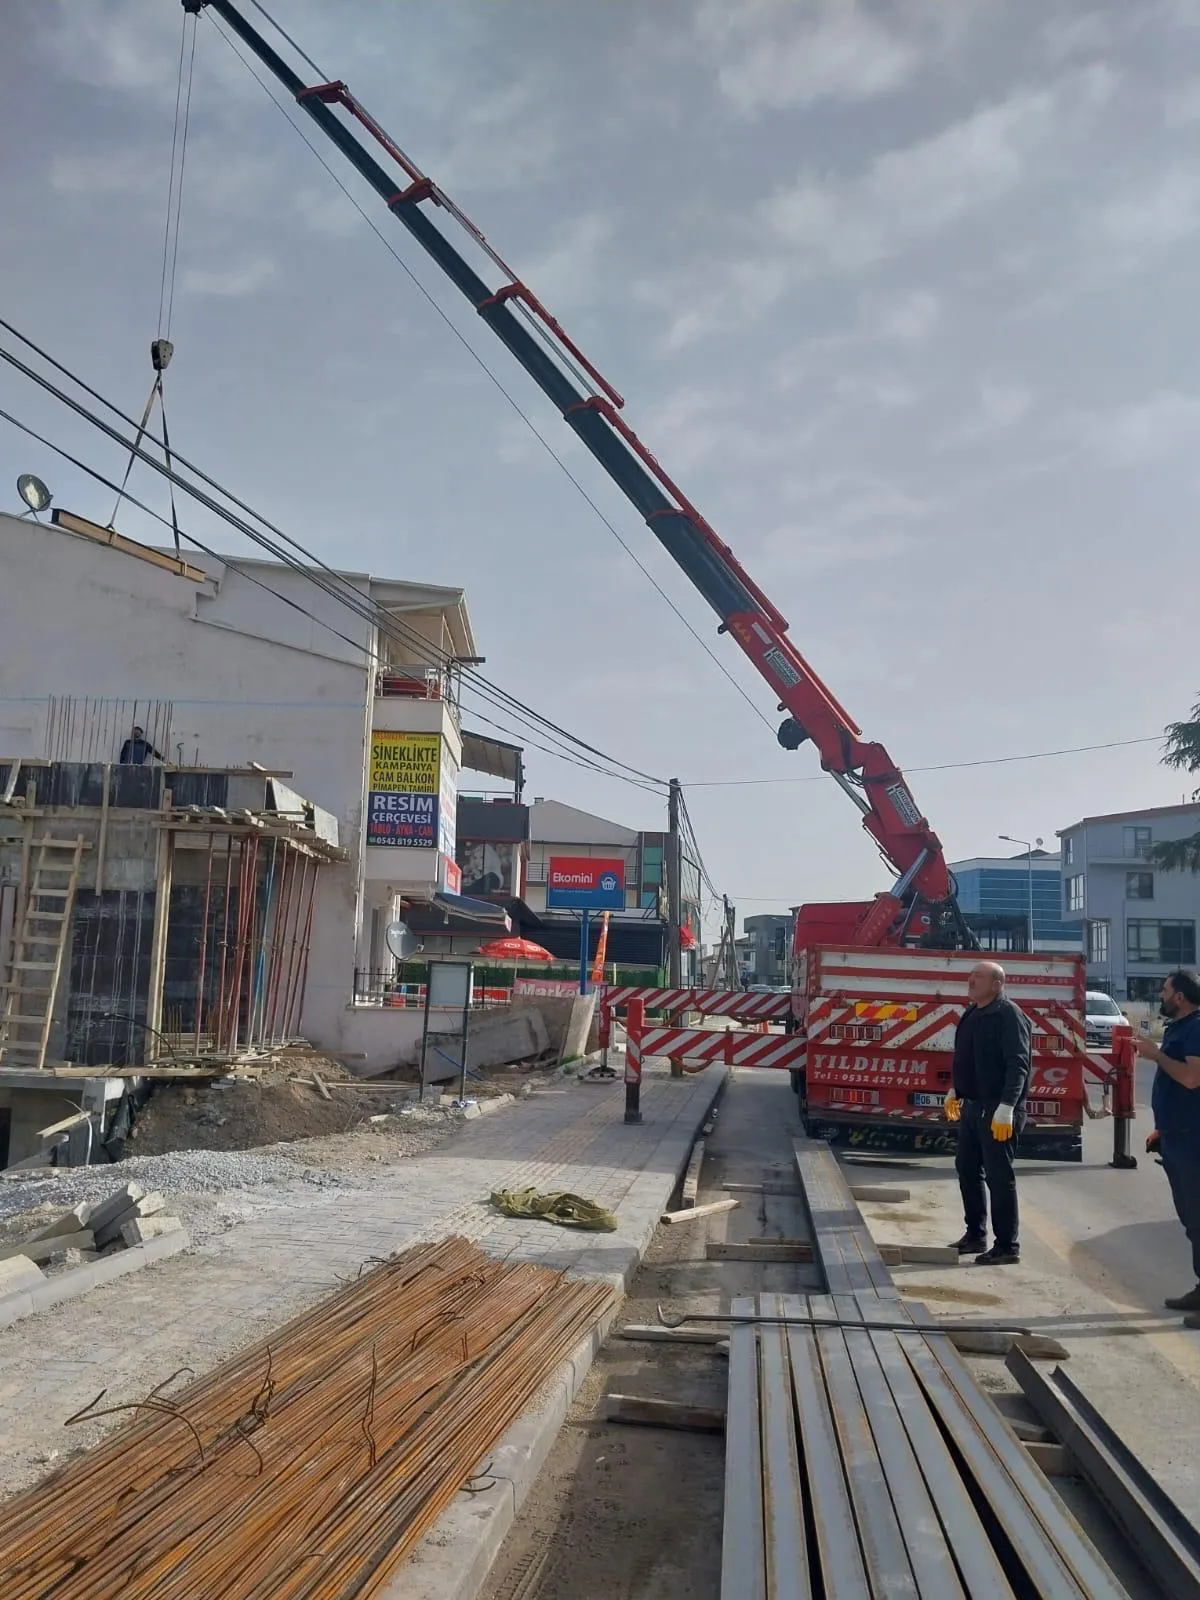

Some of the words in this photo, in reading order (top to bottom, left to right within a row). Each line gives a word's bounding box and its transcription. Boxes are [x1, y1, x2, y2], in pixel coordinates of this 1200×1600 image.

[373, 742, 437, 762] SİNEKLİKTE
[376, 761, 433, 772] KAMPANYA
[373, 771, 394, 783] CAM
[396, 773, 435, 784] BALKON
[373, 794, 433, 812] RESİM
[372, 812, 431, 824] ÇERÇEVESİ
[376, 837, 396, 845] 0542
[397, 838, 413, 846] 819
[413, 838, 433, 847] 5529
[553, 872, 593, 883] Ekomini
[813, 1054, 929, 1075] YILDIRIM
[813, 1071, 831, 1080] Tel
[842, 1073, 869, 1082] 0532
[872, 1075, 893, 1085] 427
[896, 1077, 910, 1086] 94
[920, 1095, 931, 1105] 06
